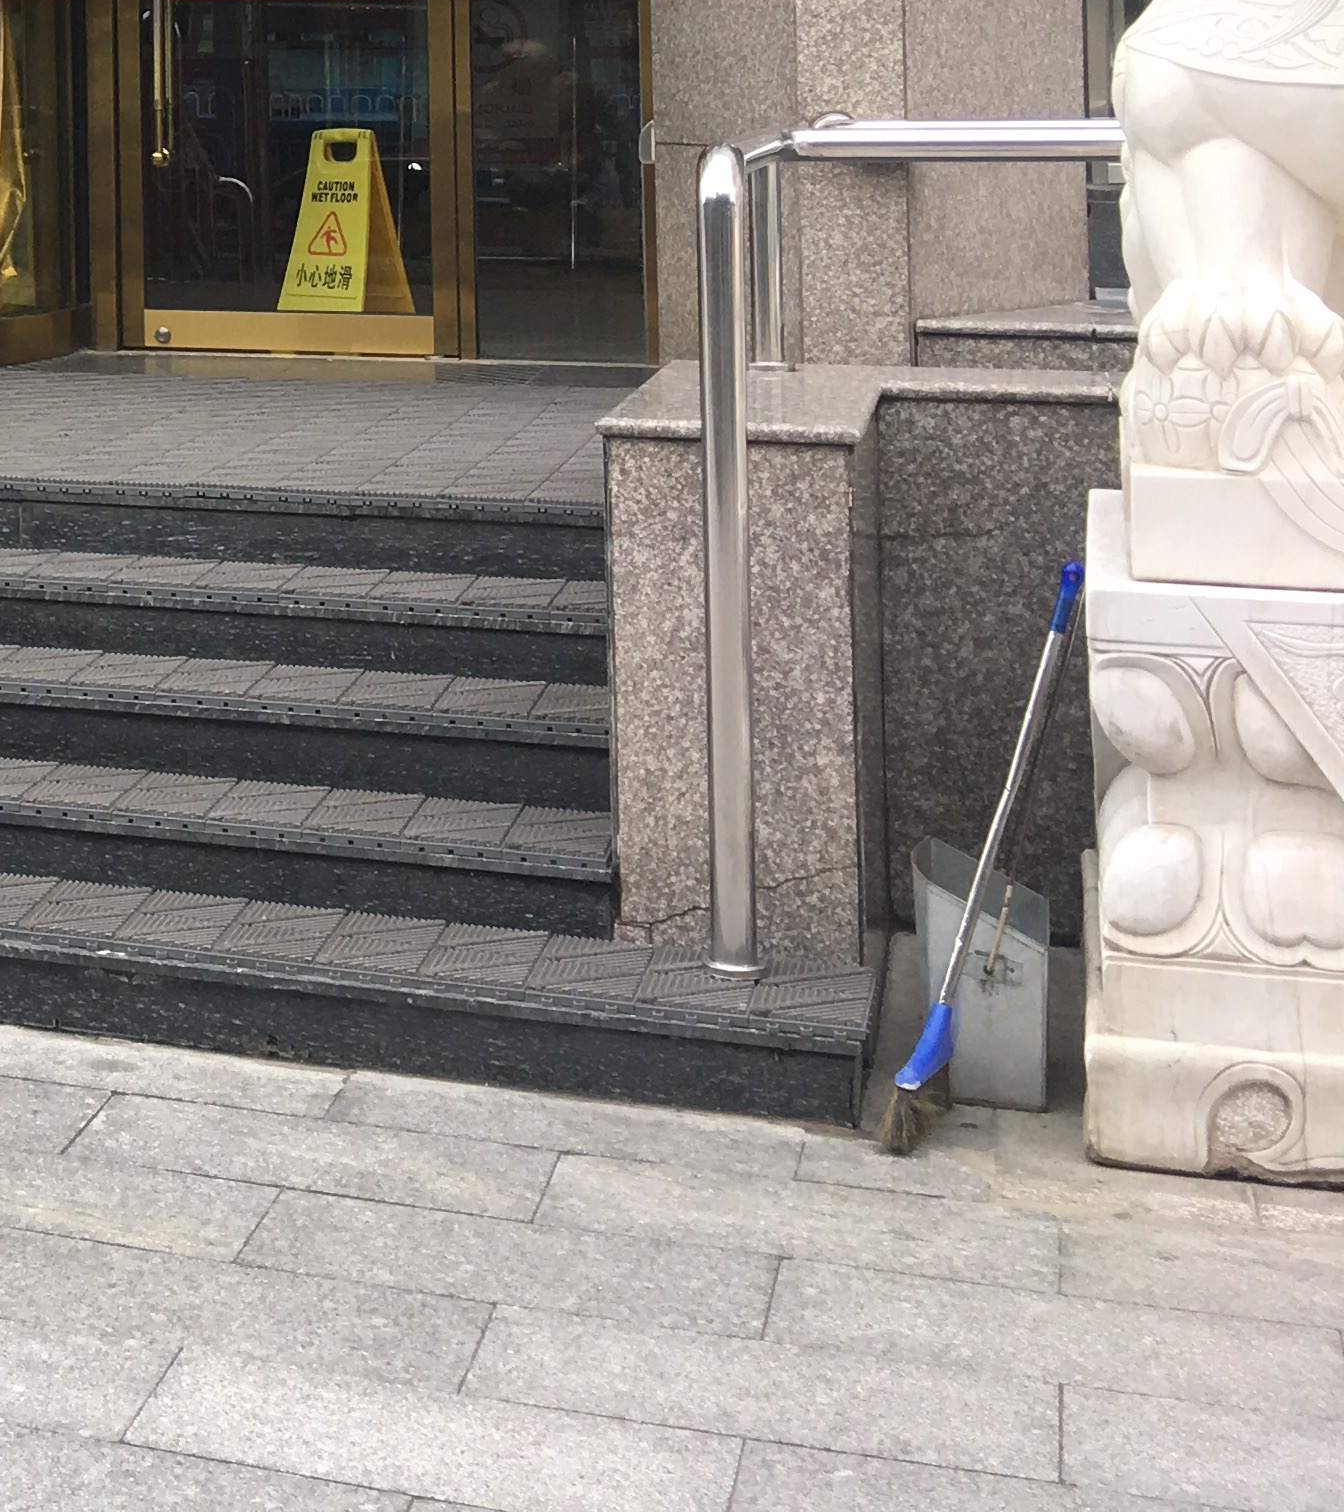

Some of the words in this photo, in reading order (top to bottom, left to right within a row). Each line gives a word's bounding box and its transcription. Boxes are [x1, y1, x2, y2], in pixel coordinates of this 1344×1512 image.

[317, 180, 355, 192] CAUTION
[311, 192, 329, 203] WET
[329, 192, 359, 204] FLOOR
[295, 262, 353, 291] 小心地滑
